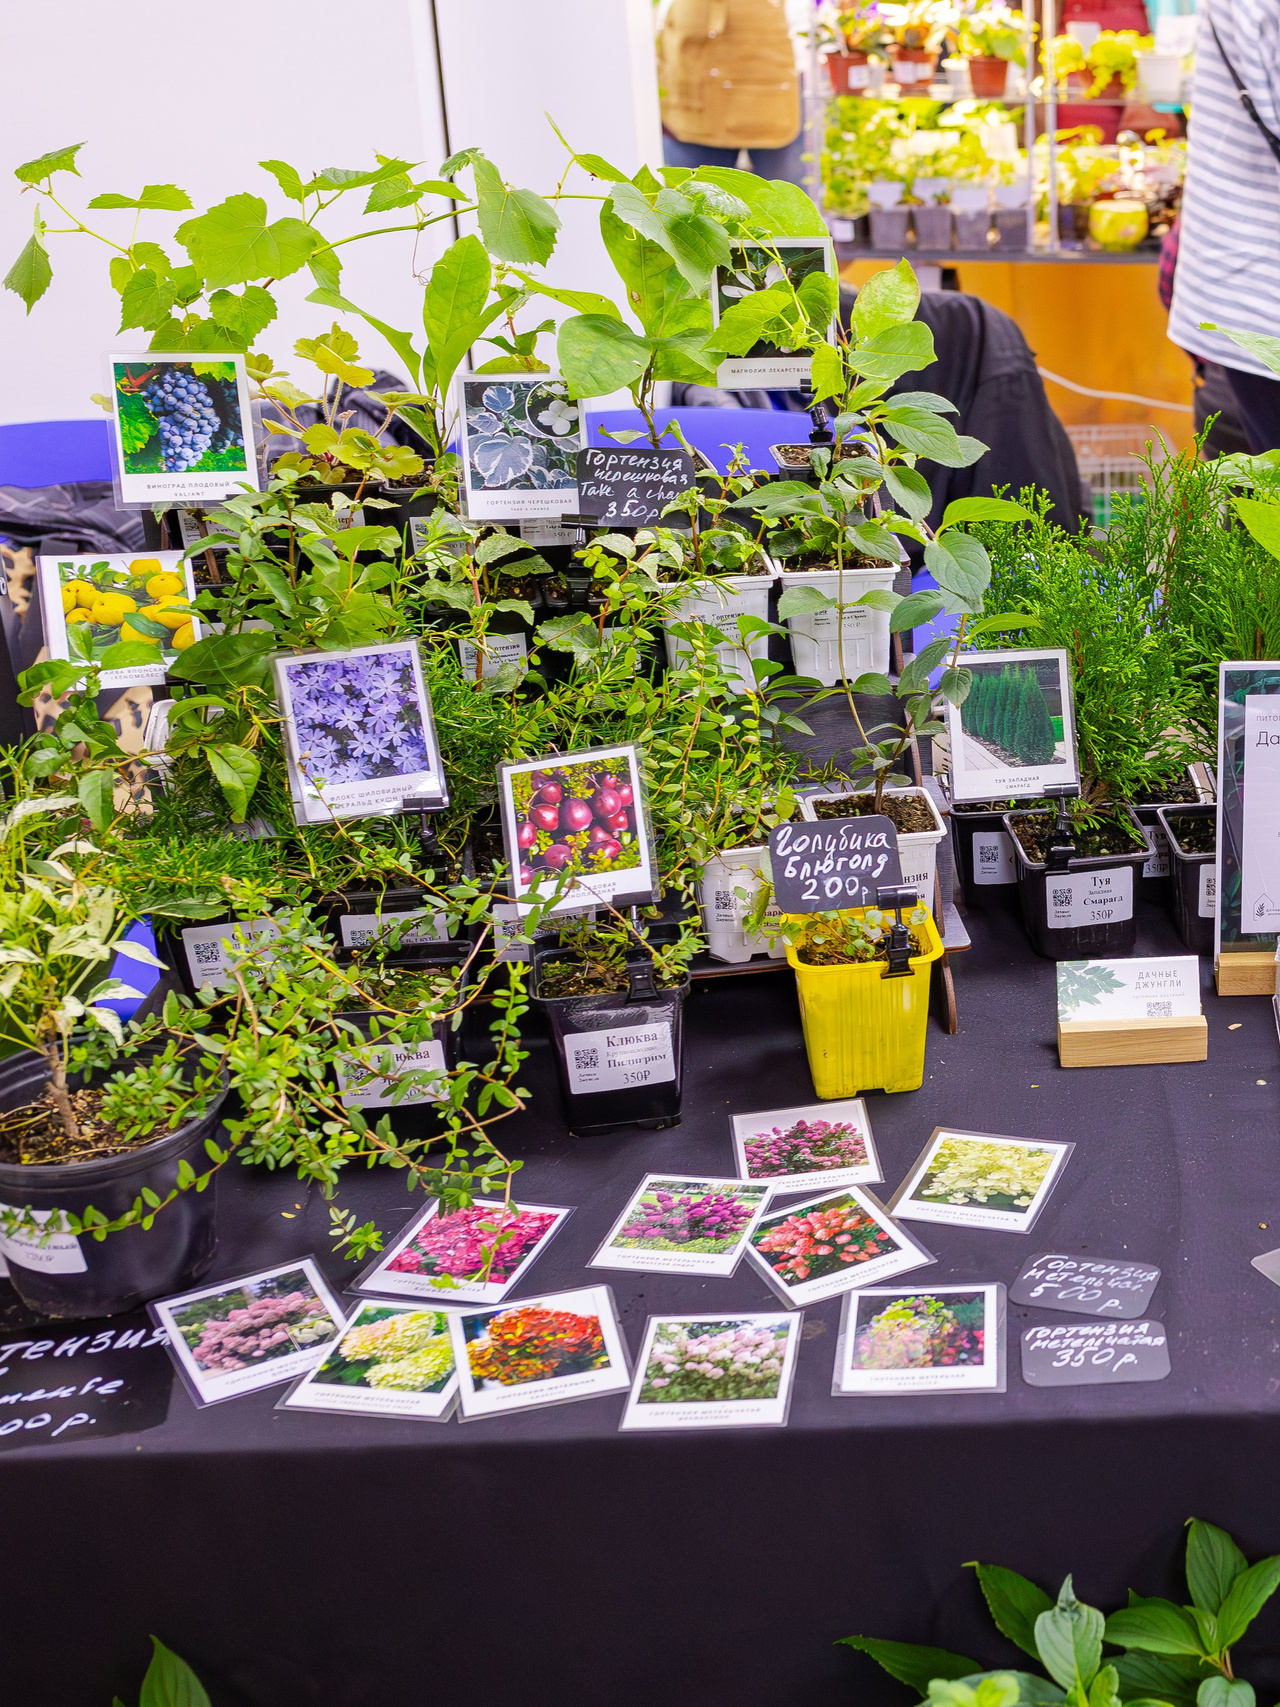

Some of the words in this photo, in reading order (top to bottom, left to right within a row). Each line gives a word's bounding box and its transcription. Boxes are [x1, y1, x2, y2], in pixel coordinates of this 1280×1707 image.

[586, 449, 683, 472] Гортензия
[188, 480, 230, 488] ПЛОДОВЫЙ
[580, 481, 614, 498] Take
[627, 488, 641, 499] a
[330, 794, 356, 802] ФЛОКС
[358, 785, 413, 798] ШИЛОВИДНЫЙ
[331, 801, 373, 810] МЕРАЛЬД
[1091, 876, 1111, 888] Туя
[1083, 895, 1123, 907] Смарагд
[1138, 970, 1178, 980] ДАЧНЫЕ
[1135, 980, 1182, 990] ДЖУНГЛИ
[606, 1032, 658, 1048] Клюква
[607, 1054, 667, 1069] Пилигрим
[1052, 1347, 1116, 1367] 350
